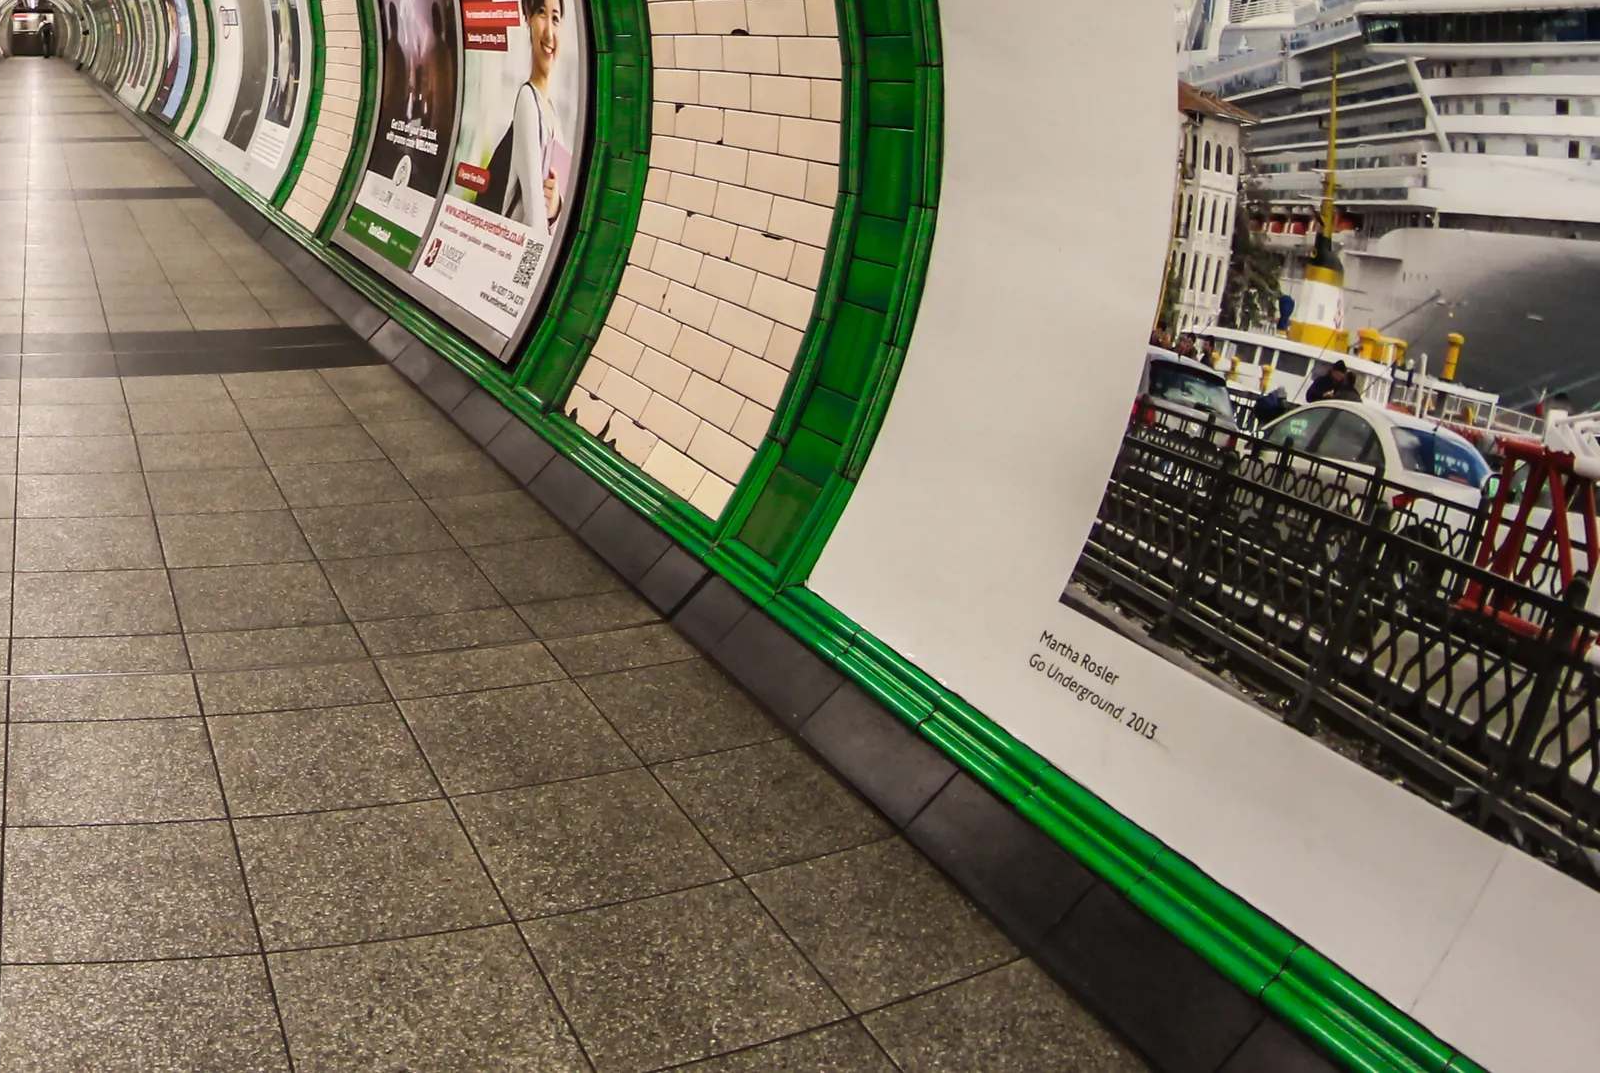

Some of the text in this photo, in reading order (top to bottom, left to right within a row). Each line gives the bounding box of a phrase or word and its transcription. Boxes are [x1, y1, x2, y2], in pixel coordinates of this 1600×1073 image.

[1039, 629, 1120, 686] Martha Rosler
[1029, 653, 1158, 740] Go Underground, 2013
